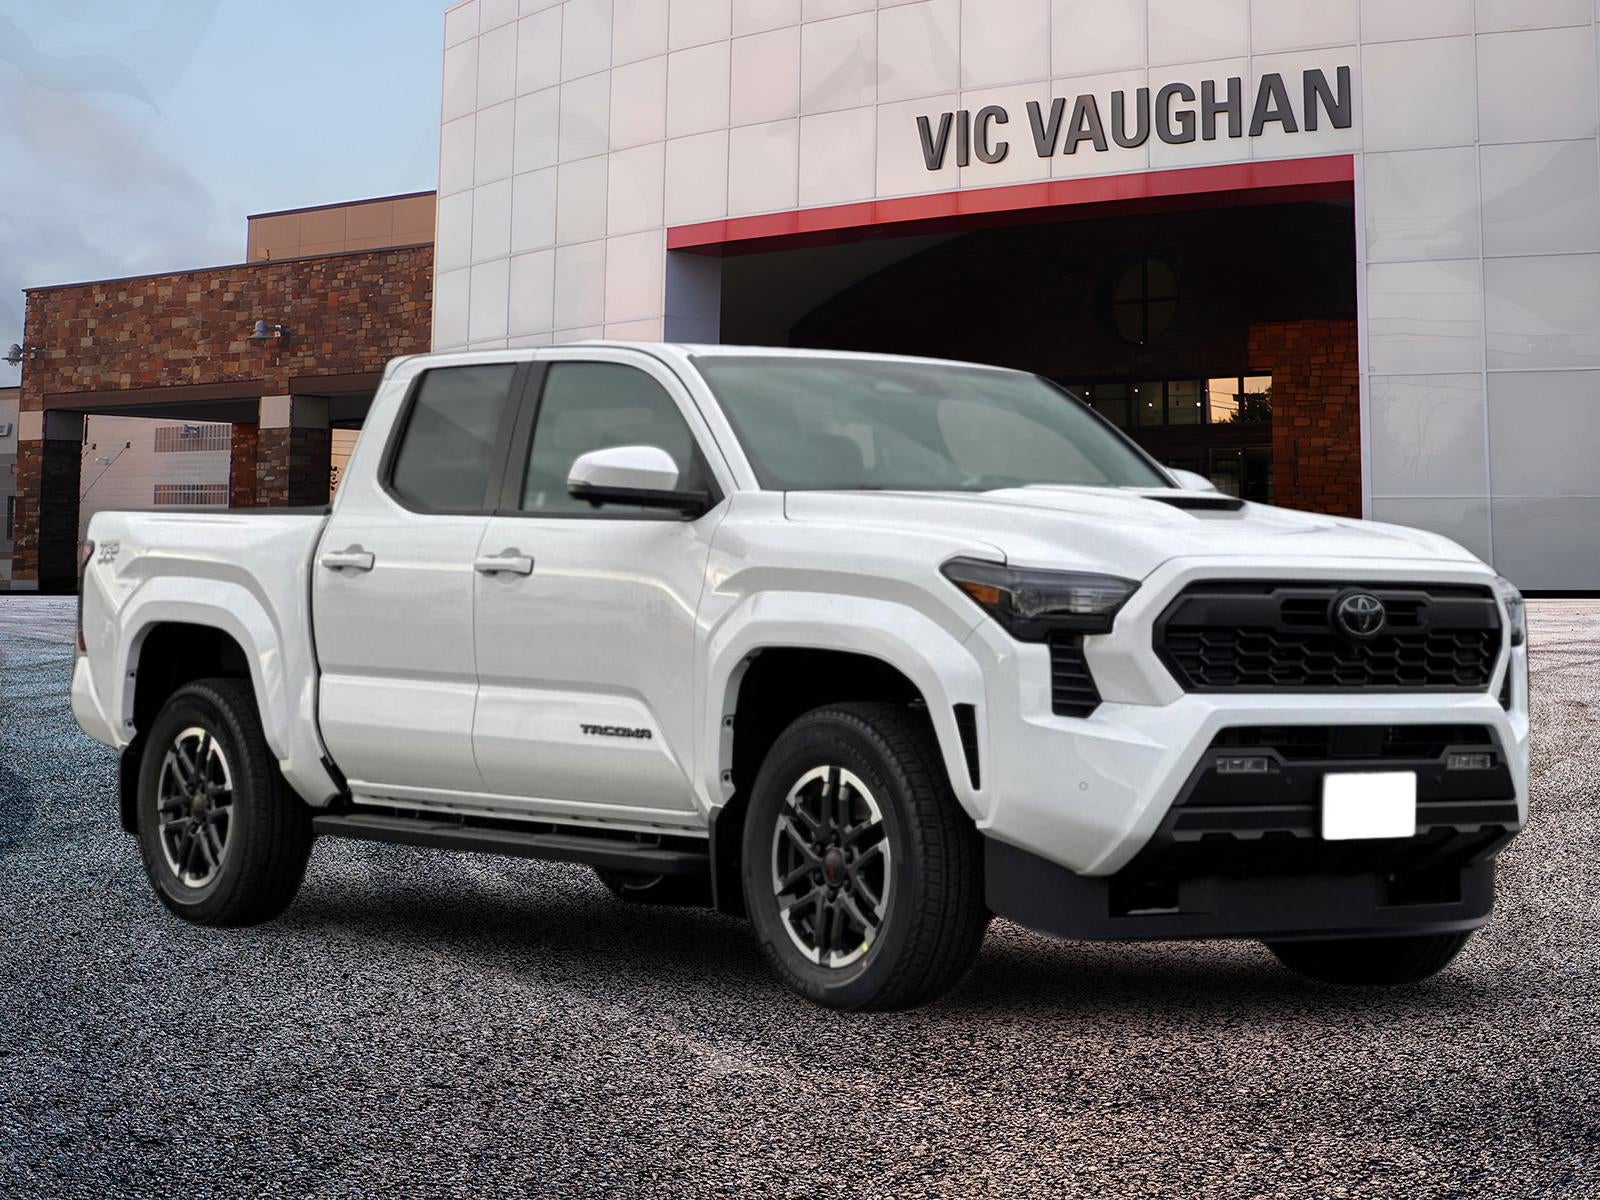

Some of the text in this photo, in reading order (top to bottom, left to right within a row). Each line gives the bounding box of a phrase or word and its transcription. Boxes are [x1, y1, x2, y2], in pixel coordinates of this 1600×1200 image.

[916, 65, 1353, 171] VIC VAUGHAN
[580, 724, 652, 739] TACOMA
